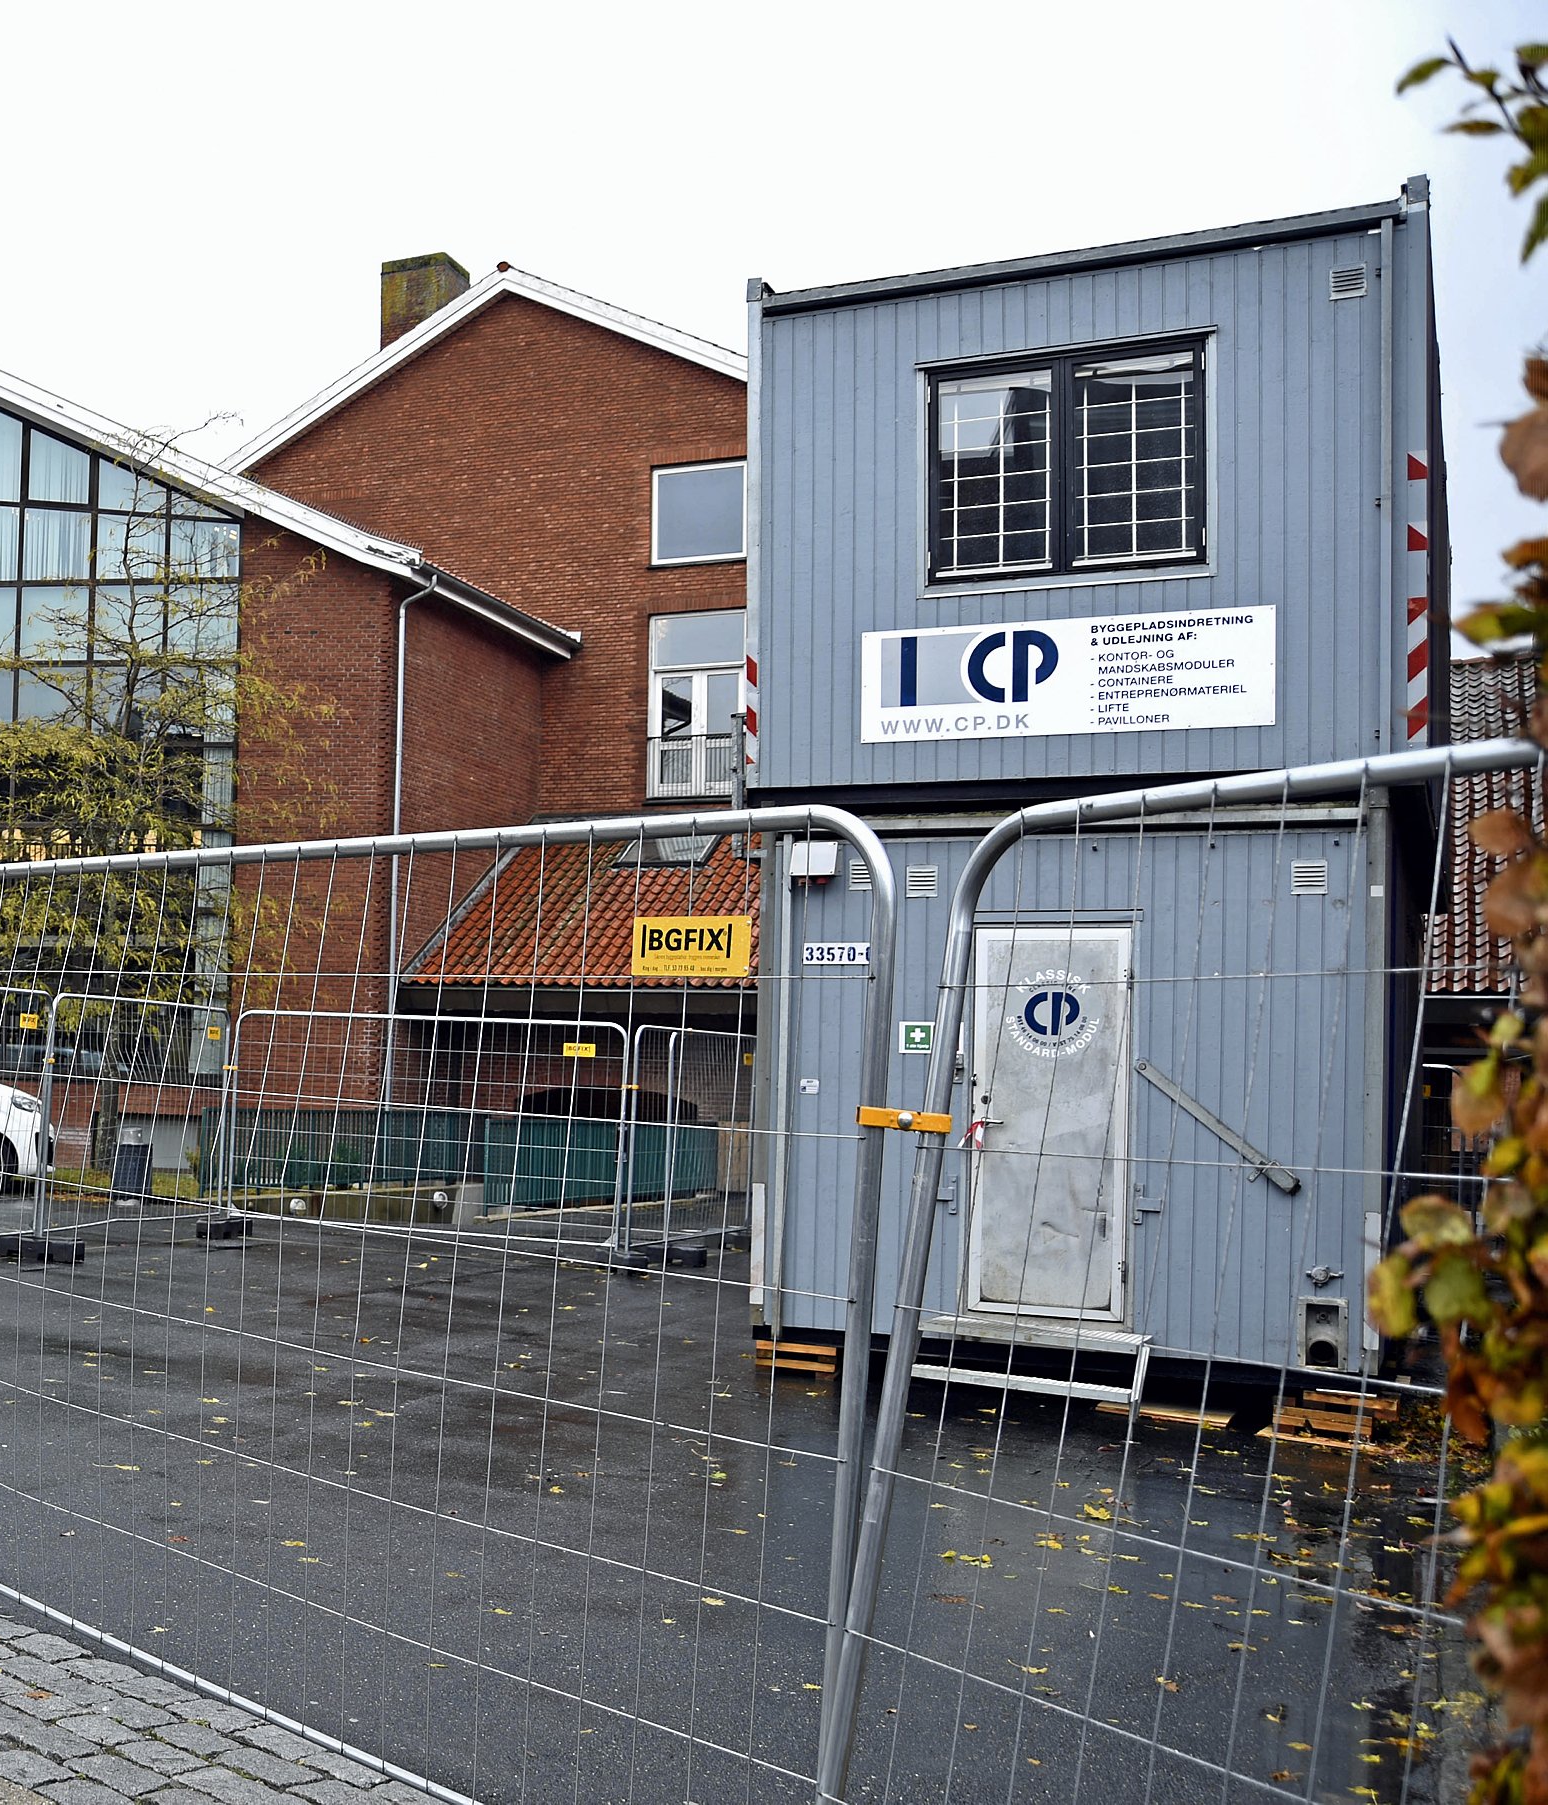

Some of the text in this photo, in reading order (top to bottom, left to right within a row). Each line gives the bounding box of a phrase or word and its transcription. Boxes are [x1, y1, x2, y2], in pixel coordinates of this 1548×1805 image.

[1090, 615, 1254, 634] BYGGEPLADSINDRETNING
[1090, 632, 1198, 646] & UDLEJNING AF:
[1098, 649, 1175, 663] KONTOR- OG
[1098, 659, 1235, 675] MANDSKABSMODULER
[1098, 675, 1174, 687] CONTAINERE
[1098, 685, 1248, 701] ENTREPRENØRMATERIEL
[1098, 703, 1130, 713] LIFTE
[881, 713, 1030, 735] WWW.CP.DK
[1098, 714, 1170, 726] PAVILLONER
[1015, 969, 1091, 995] KLASSISK
[1005, 1016, 1101, 1058] STANDARD-MODUL
